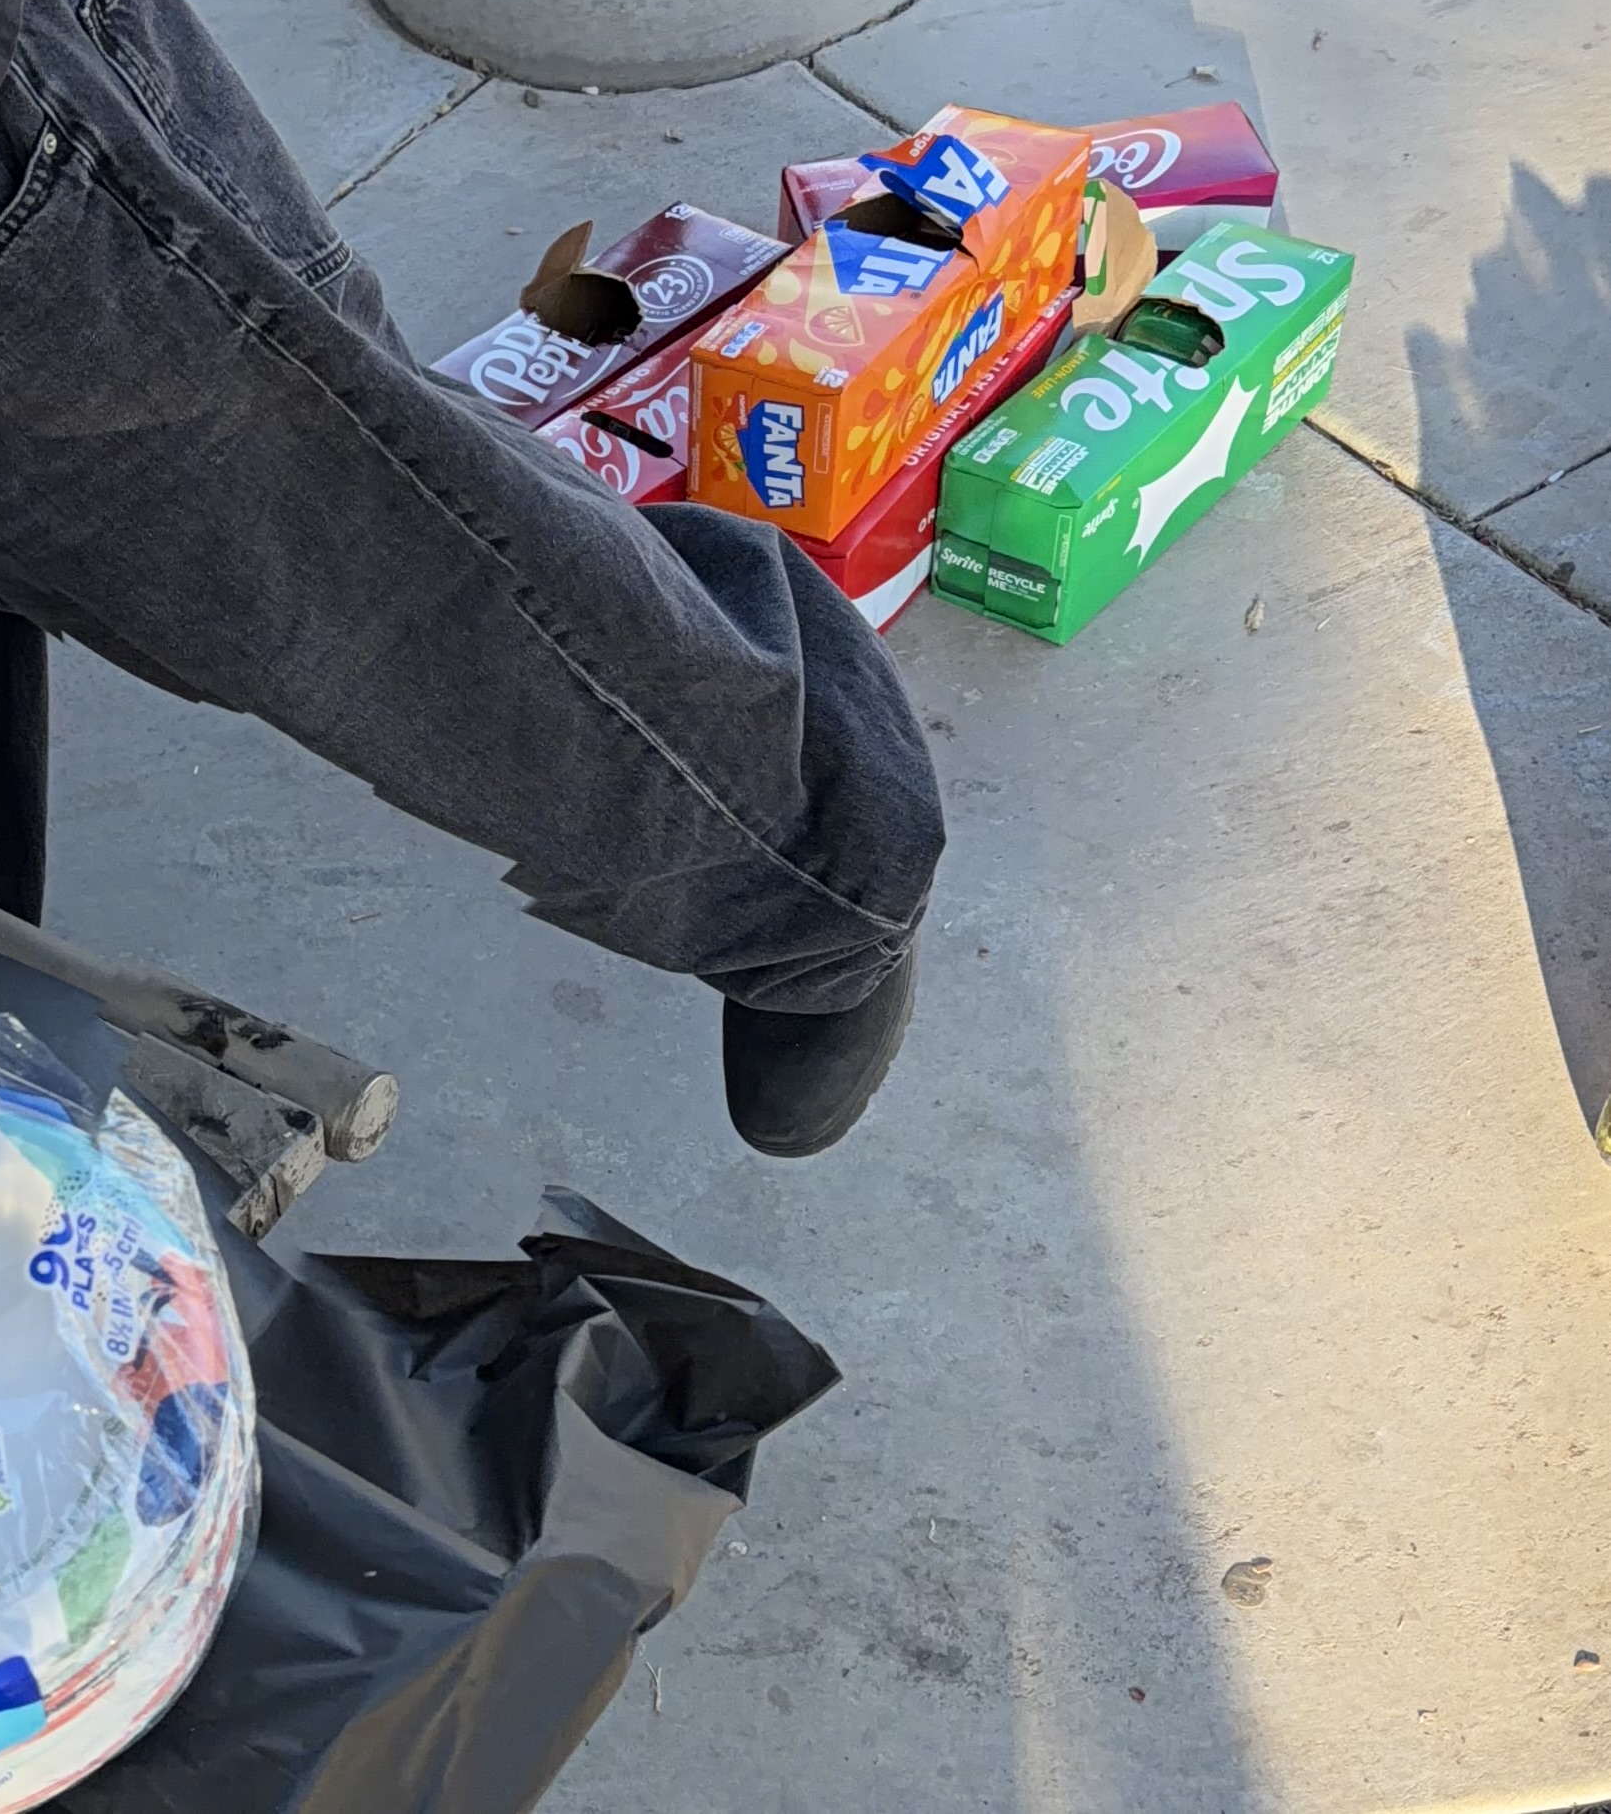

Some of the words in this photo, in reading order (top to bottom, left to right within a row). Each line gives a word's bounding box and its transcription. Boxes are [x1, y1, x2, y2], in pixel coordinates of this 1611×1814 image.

[665, 203, 695, 220] 12
[642, 273, 686, 304] 23
[933, 298, 1003, 405] FANTA
[1034, 349, 1090, 401] LEMON-LIME
[904, 398, 970, 465] ORIGINAL
[762, 400, 804, 508] FANTA
[1081, 497, 1119, 538] Sprite
[940, 547, 984, 574] Sprite
[988, 566, 1045, 595] RECYCLE
[988, 577, 1007, 590] ME
